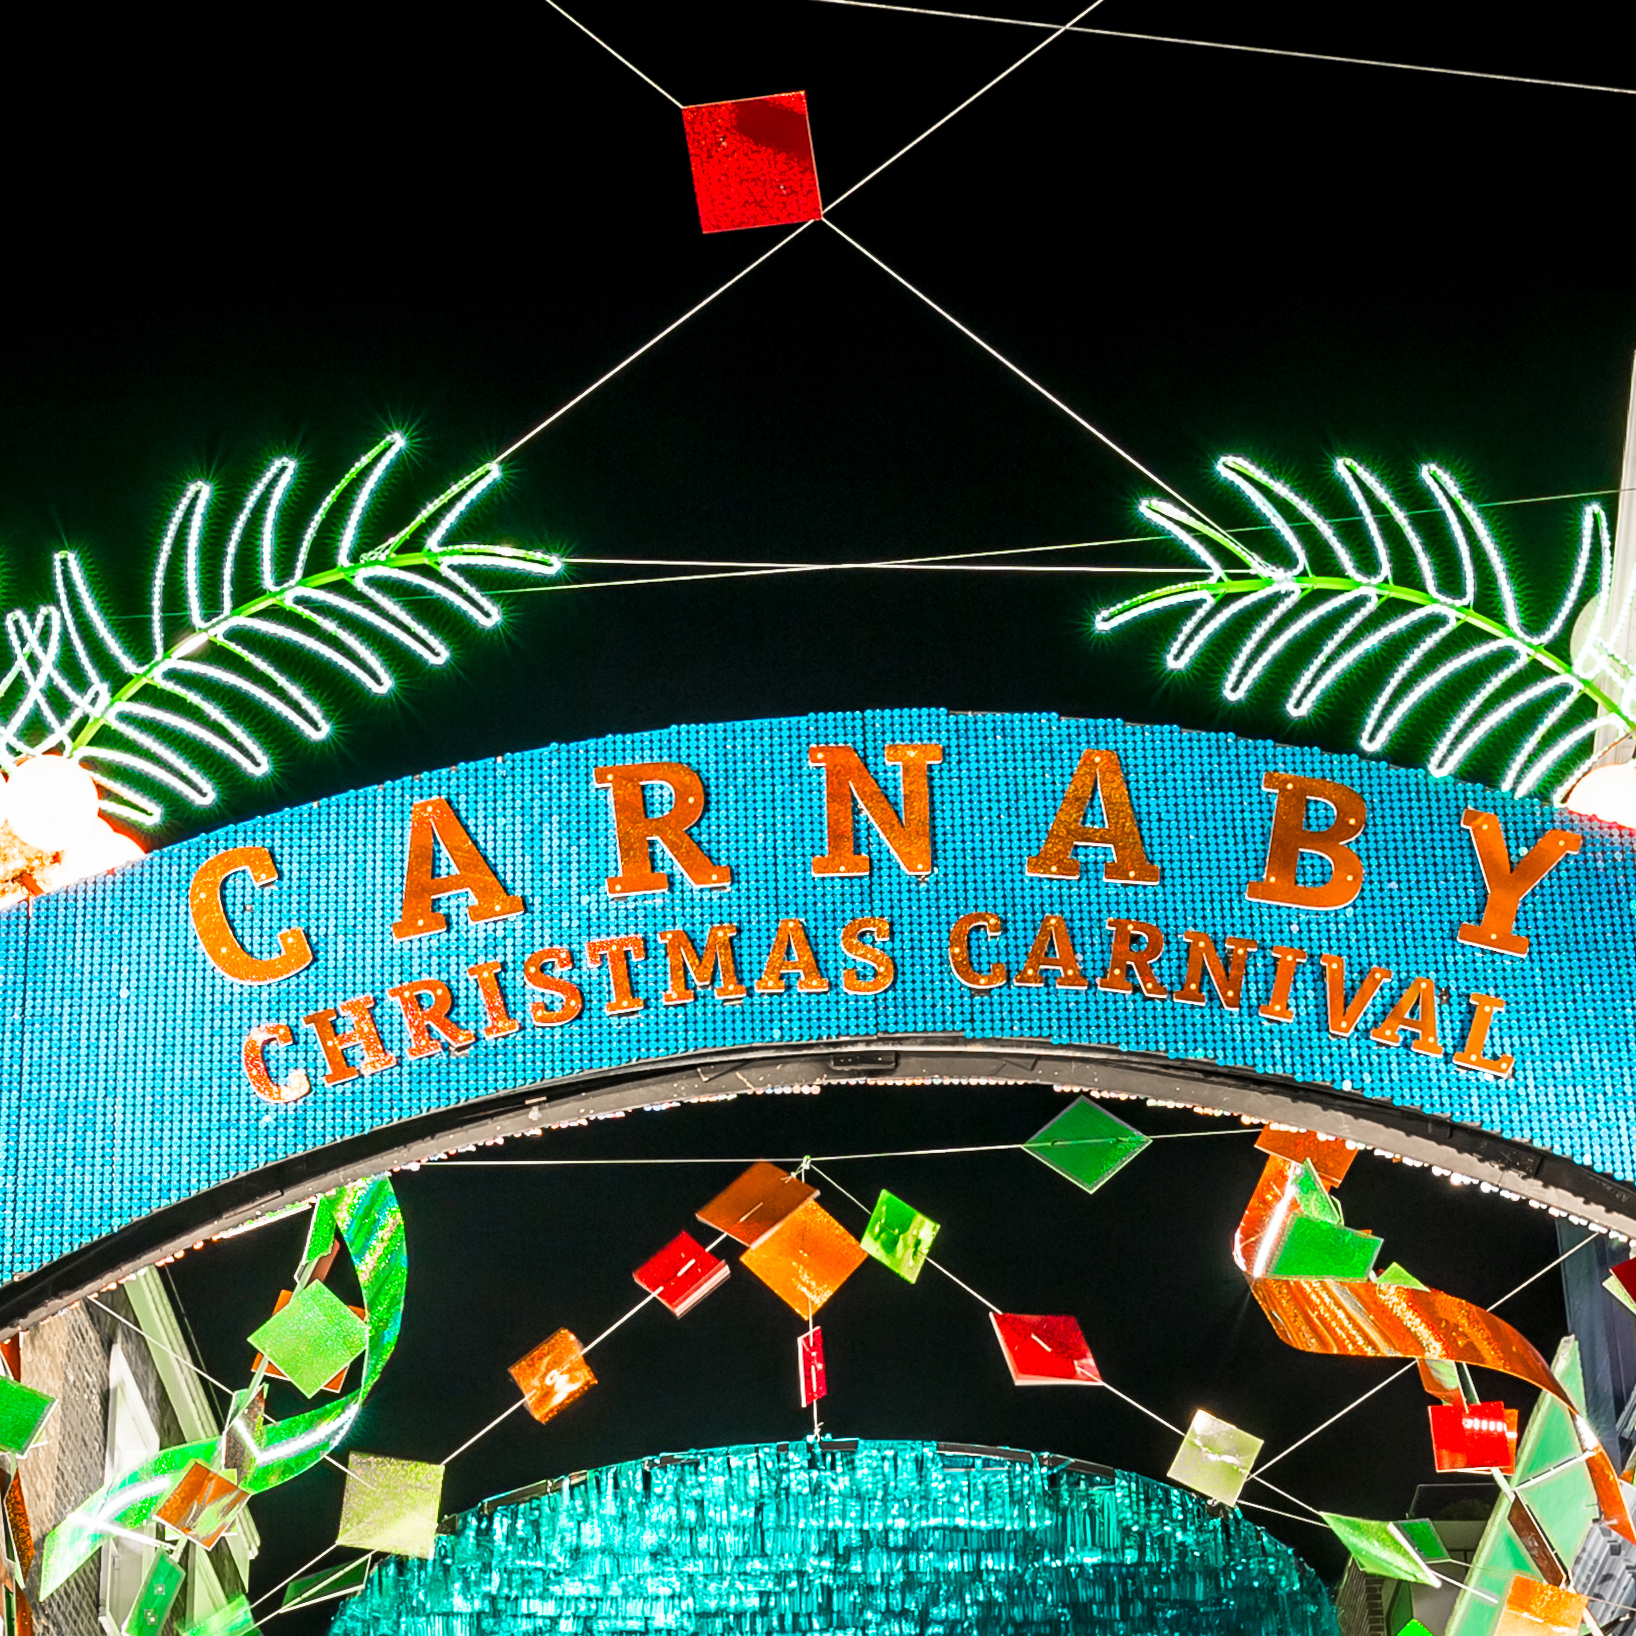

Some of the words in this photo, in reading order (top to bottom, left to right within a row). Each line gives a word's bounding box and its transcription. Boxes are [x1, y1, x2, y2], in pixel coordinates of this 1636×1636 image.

[187, 742, 1583, 986] CARNABY
[241, 915, 896, 1105] CHRISTMAS
[948, 911, 1515, 1080] CARNIVAL
